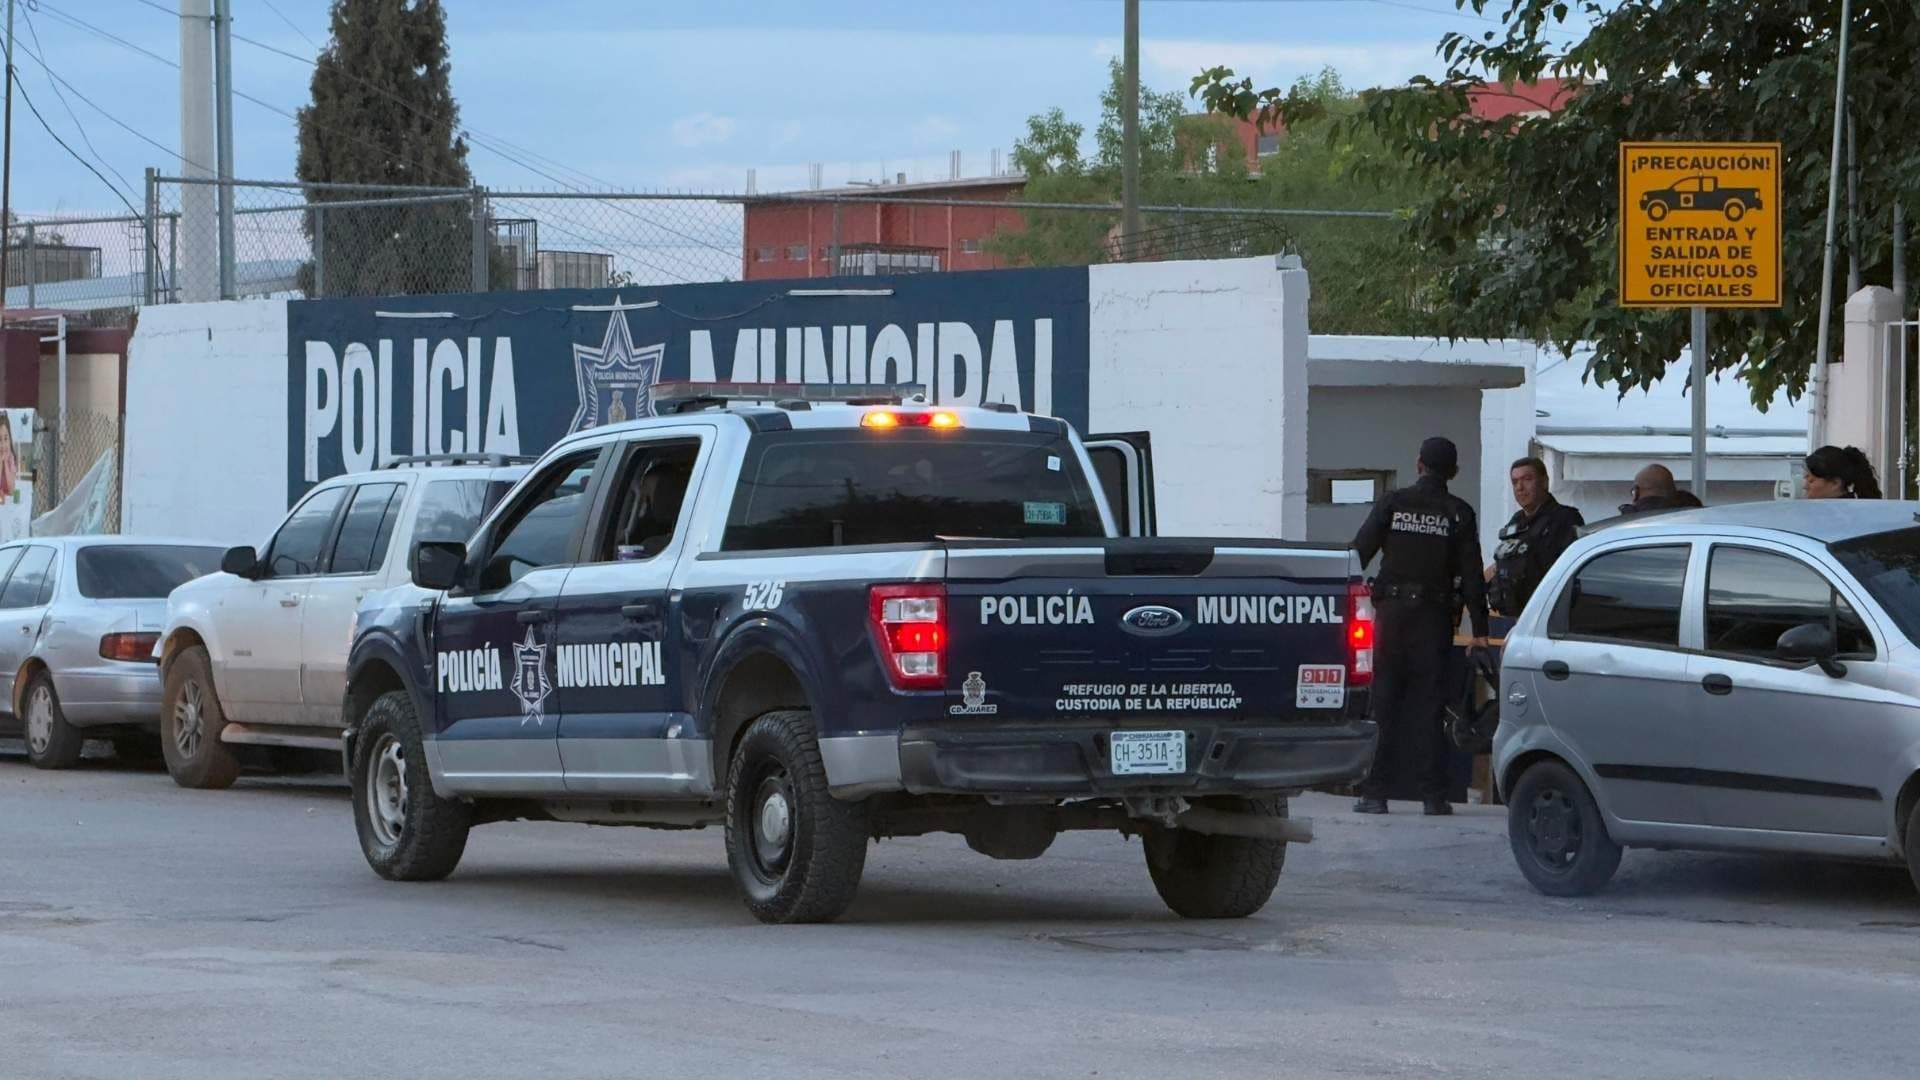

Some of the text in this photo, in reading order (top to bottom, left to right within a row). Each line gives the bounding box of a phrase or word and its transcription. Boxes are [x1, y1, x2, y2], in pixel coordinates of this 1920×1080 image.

[1632, 153, 1770, 173] ¡PRECAUCIÓN!
[1646, 227, 1757, 240] ENTRADA Y
[1651, 246, 1752, 259] SALIDA DE
[1645, 262, 1757, 278] VEHÍCULOS
[1650, 284, 1752, 297] OFICIALES
[304, 336, 520, 482] POLICIA
[1392, 521, 1448, 536] MUNICIPAL
[742, 580, 785, 610] 526
[981, 588, 1343, 625] POLICÍA MUNICIPAL
[1127, 611, 1171, 627] Ford
[438, 641, 665, 692] POLICÍA MUNICIPAL
[1304, 670, 1338, 682] 911
[1130, 684, 1147, 695] DE
[1151, 684, 1167, 695] LA
[1171, 684, 1235, 696] LIBERTAD,
[1056, 699, 1121, 710] CUSTODIA
[1125, 699, 1142, 710] DE
[1146, 699, 1162, 709] LA
[1115, 742, 1183, 761] CH-351A-3
